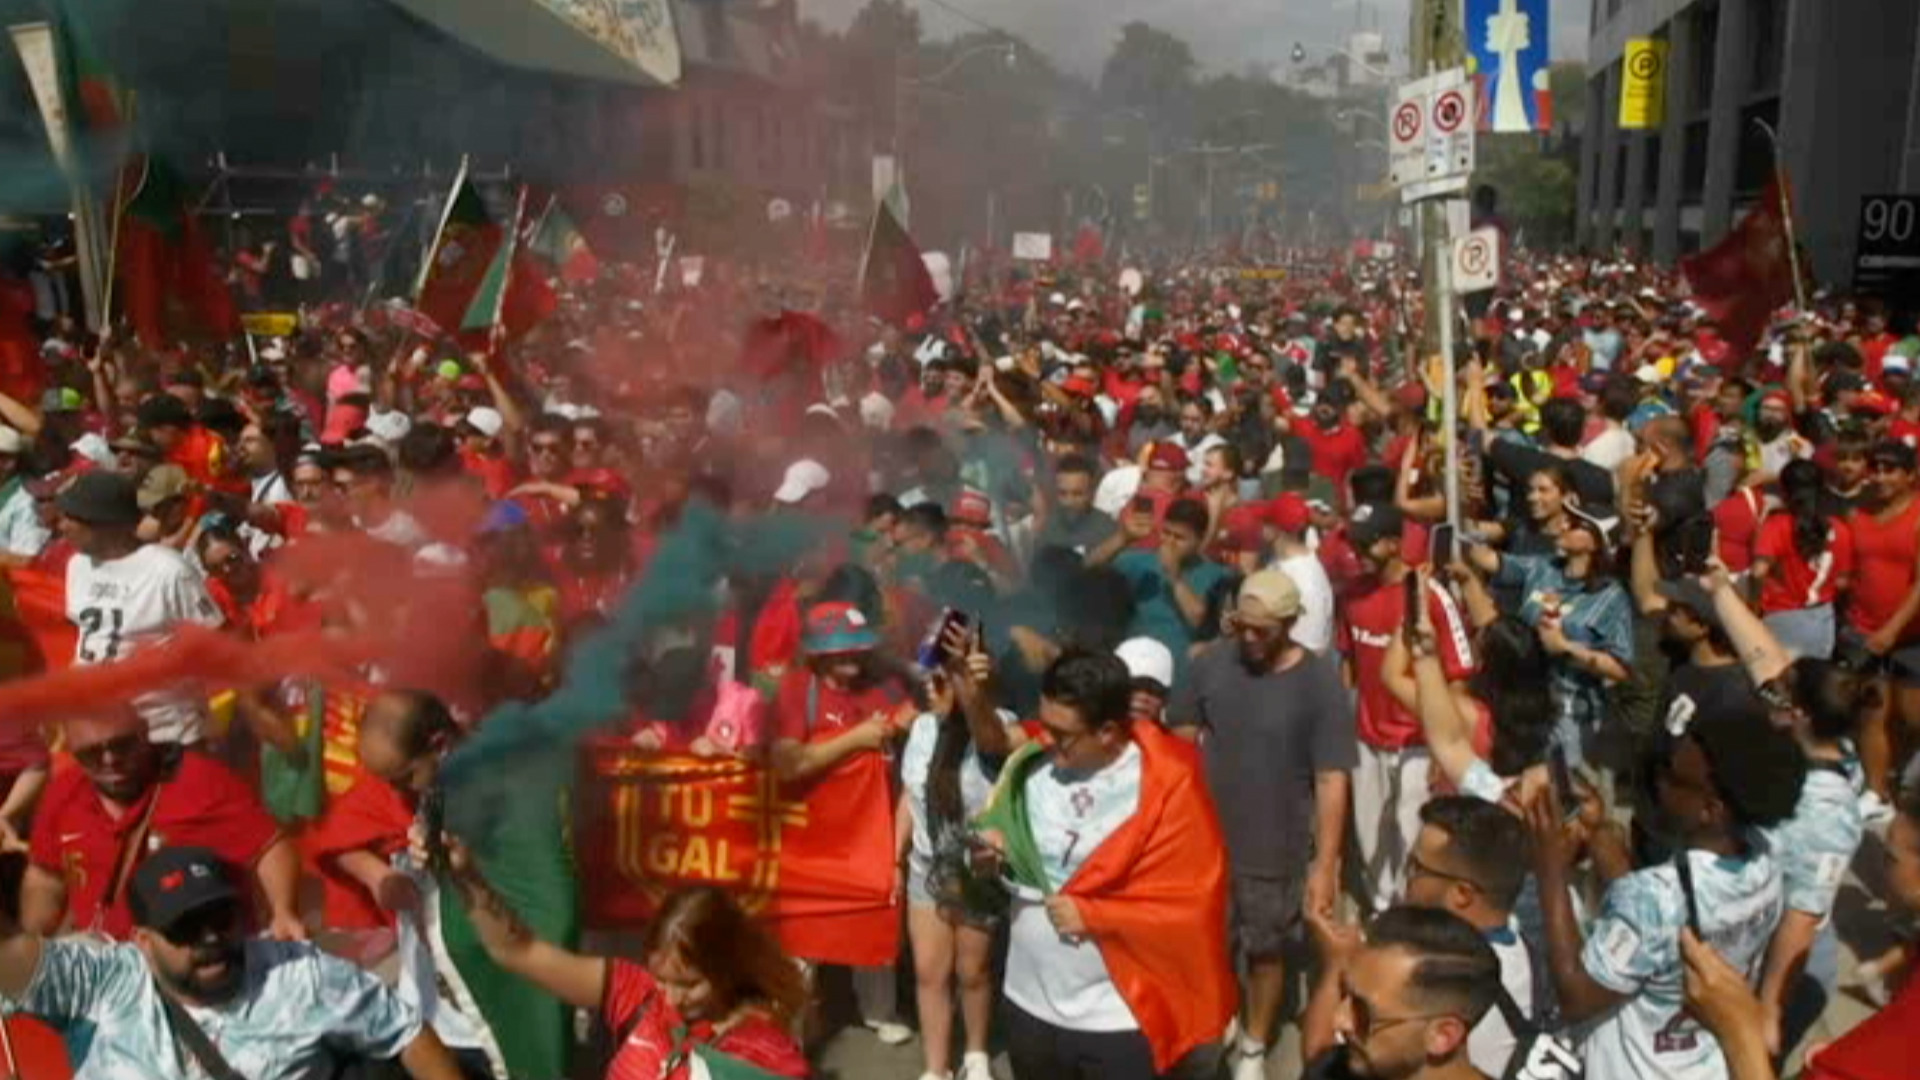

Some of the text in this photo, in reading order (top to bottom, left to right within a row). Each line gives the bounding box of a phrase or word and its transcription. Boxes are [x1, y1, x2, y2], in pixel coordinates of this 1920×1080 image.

[1863, 199, 1915, 240] 90
[79, 606, 123, 661] 21
[658, 782, 713, 828] TU
[648, 833, 741, 880] GAL
[1061, 829, 1079, 869] 7
